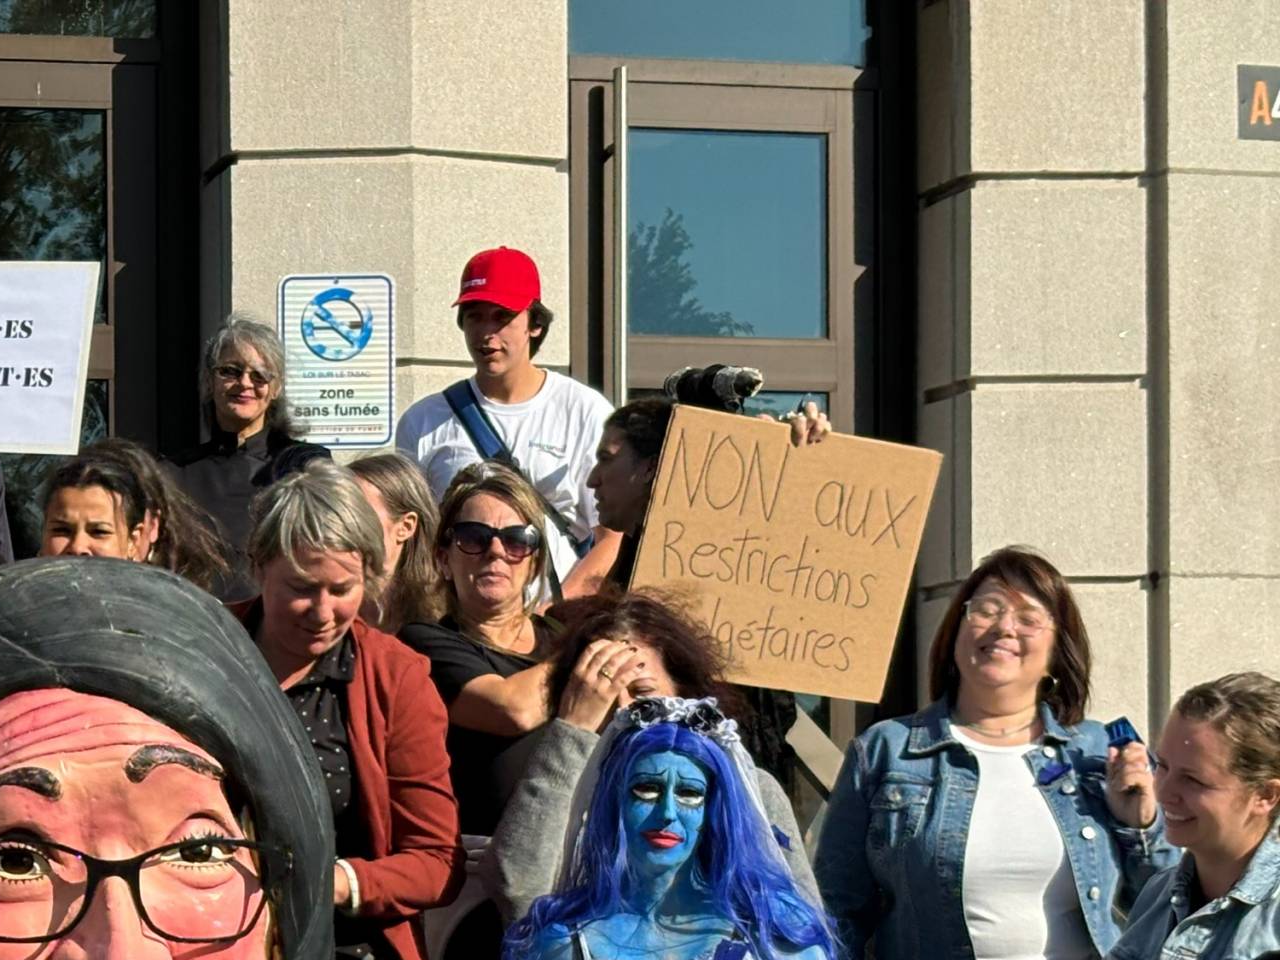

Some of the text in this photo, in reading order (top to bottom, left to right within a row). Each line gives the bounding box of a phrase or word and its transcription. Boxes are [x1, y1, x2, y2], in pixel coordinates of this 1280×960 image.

[295, 403, 380, 416] sans fumée
[319, 388, 354, 399] zone
[663, 428, 917, 549] NON aux
[663, 521, 877, 609] Restrictions
